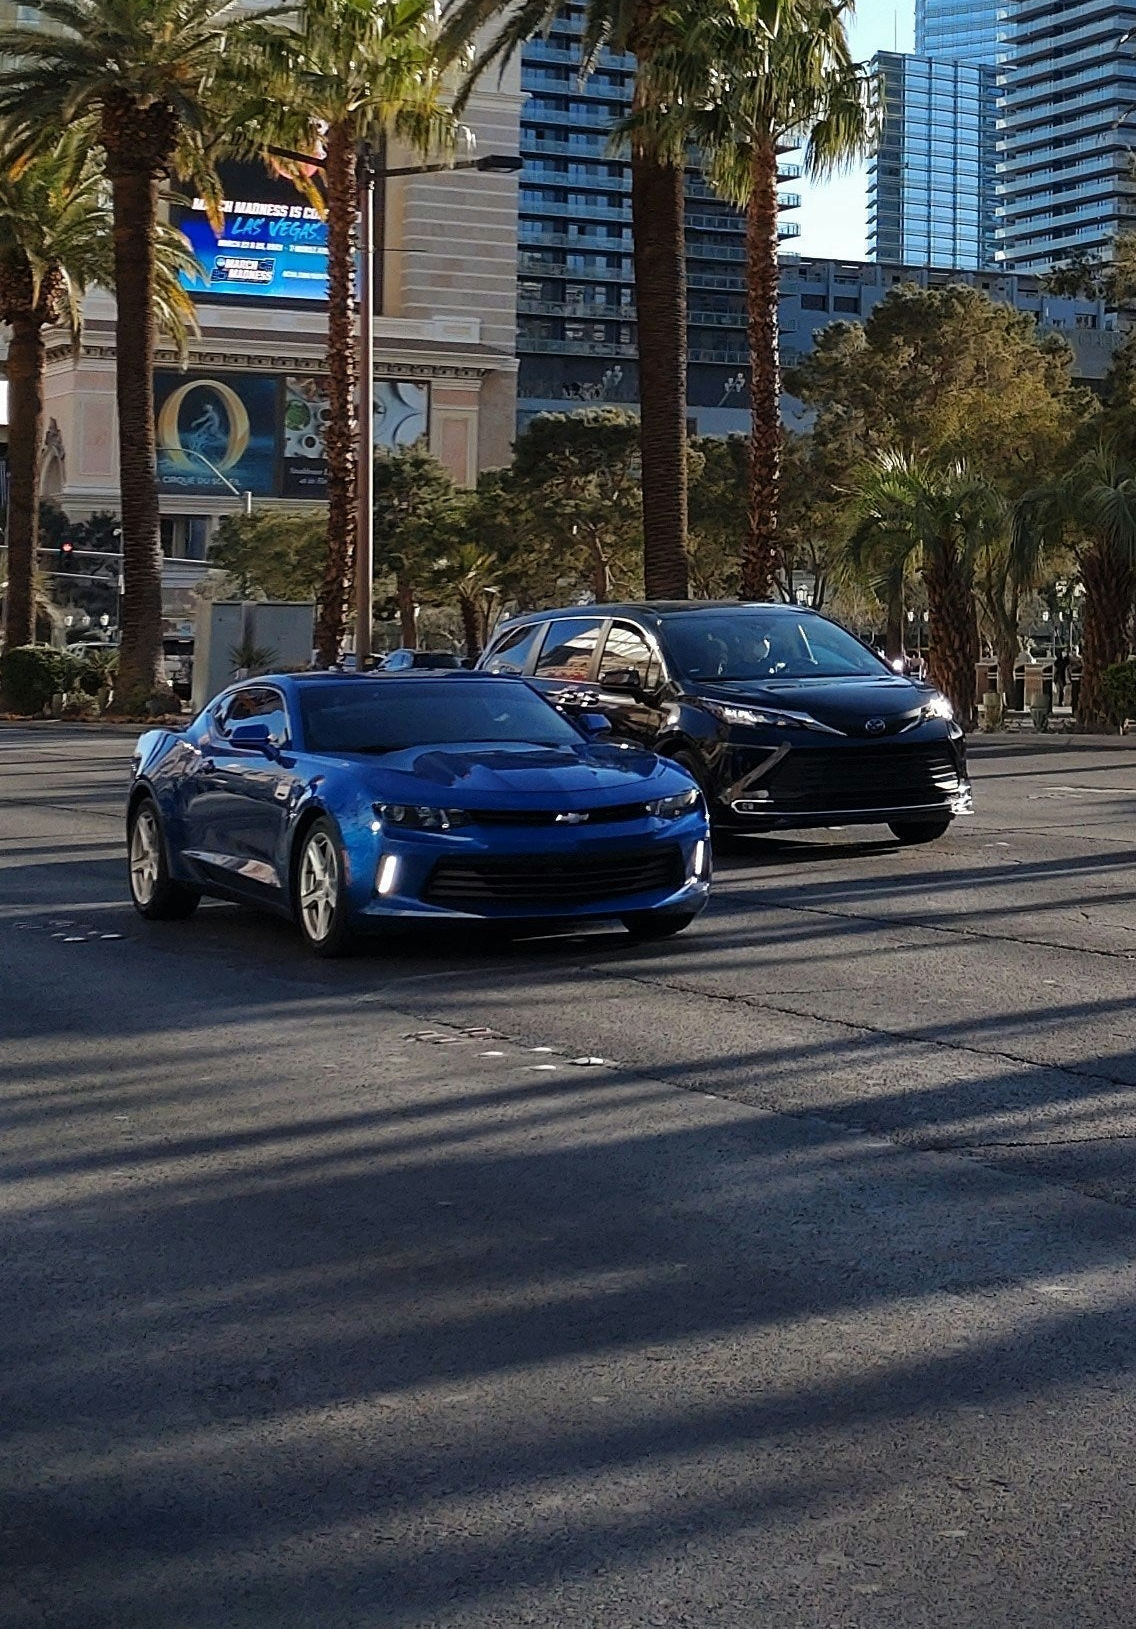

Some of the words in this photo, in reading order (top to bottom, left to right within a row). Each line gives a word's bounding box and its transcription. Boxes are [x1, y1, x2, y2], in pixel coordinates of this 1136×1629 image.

[234, 201, 288, 218] MADNESS
[289, 206, 303, 219] IS
[232, 216, 266, 236] LAS
[225, 258, 259, 270] MARCH
[228, 268, 274, 281] MADNESS
[158, 379, 250, 473] O
[163, 476, 196, 486] CIRQUE
[197, 476, 211, 485] DU
